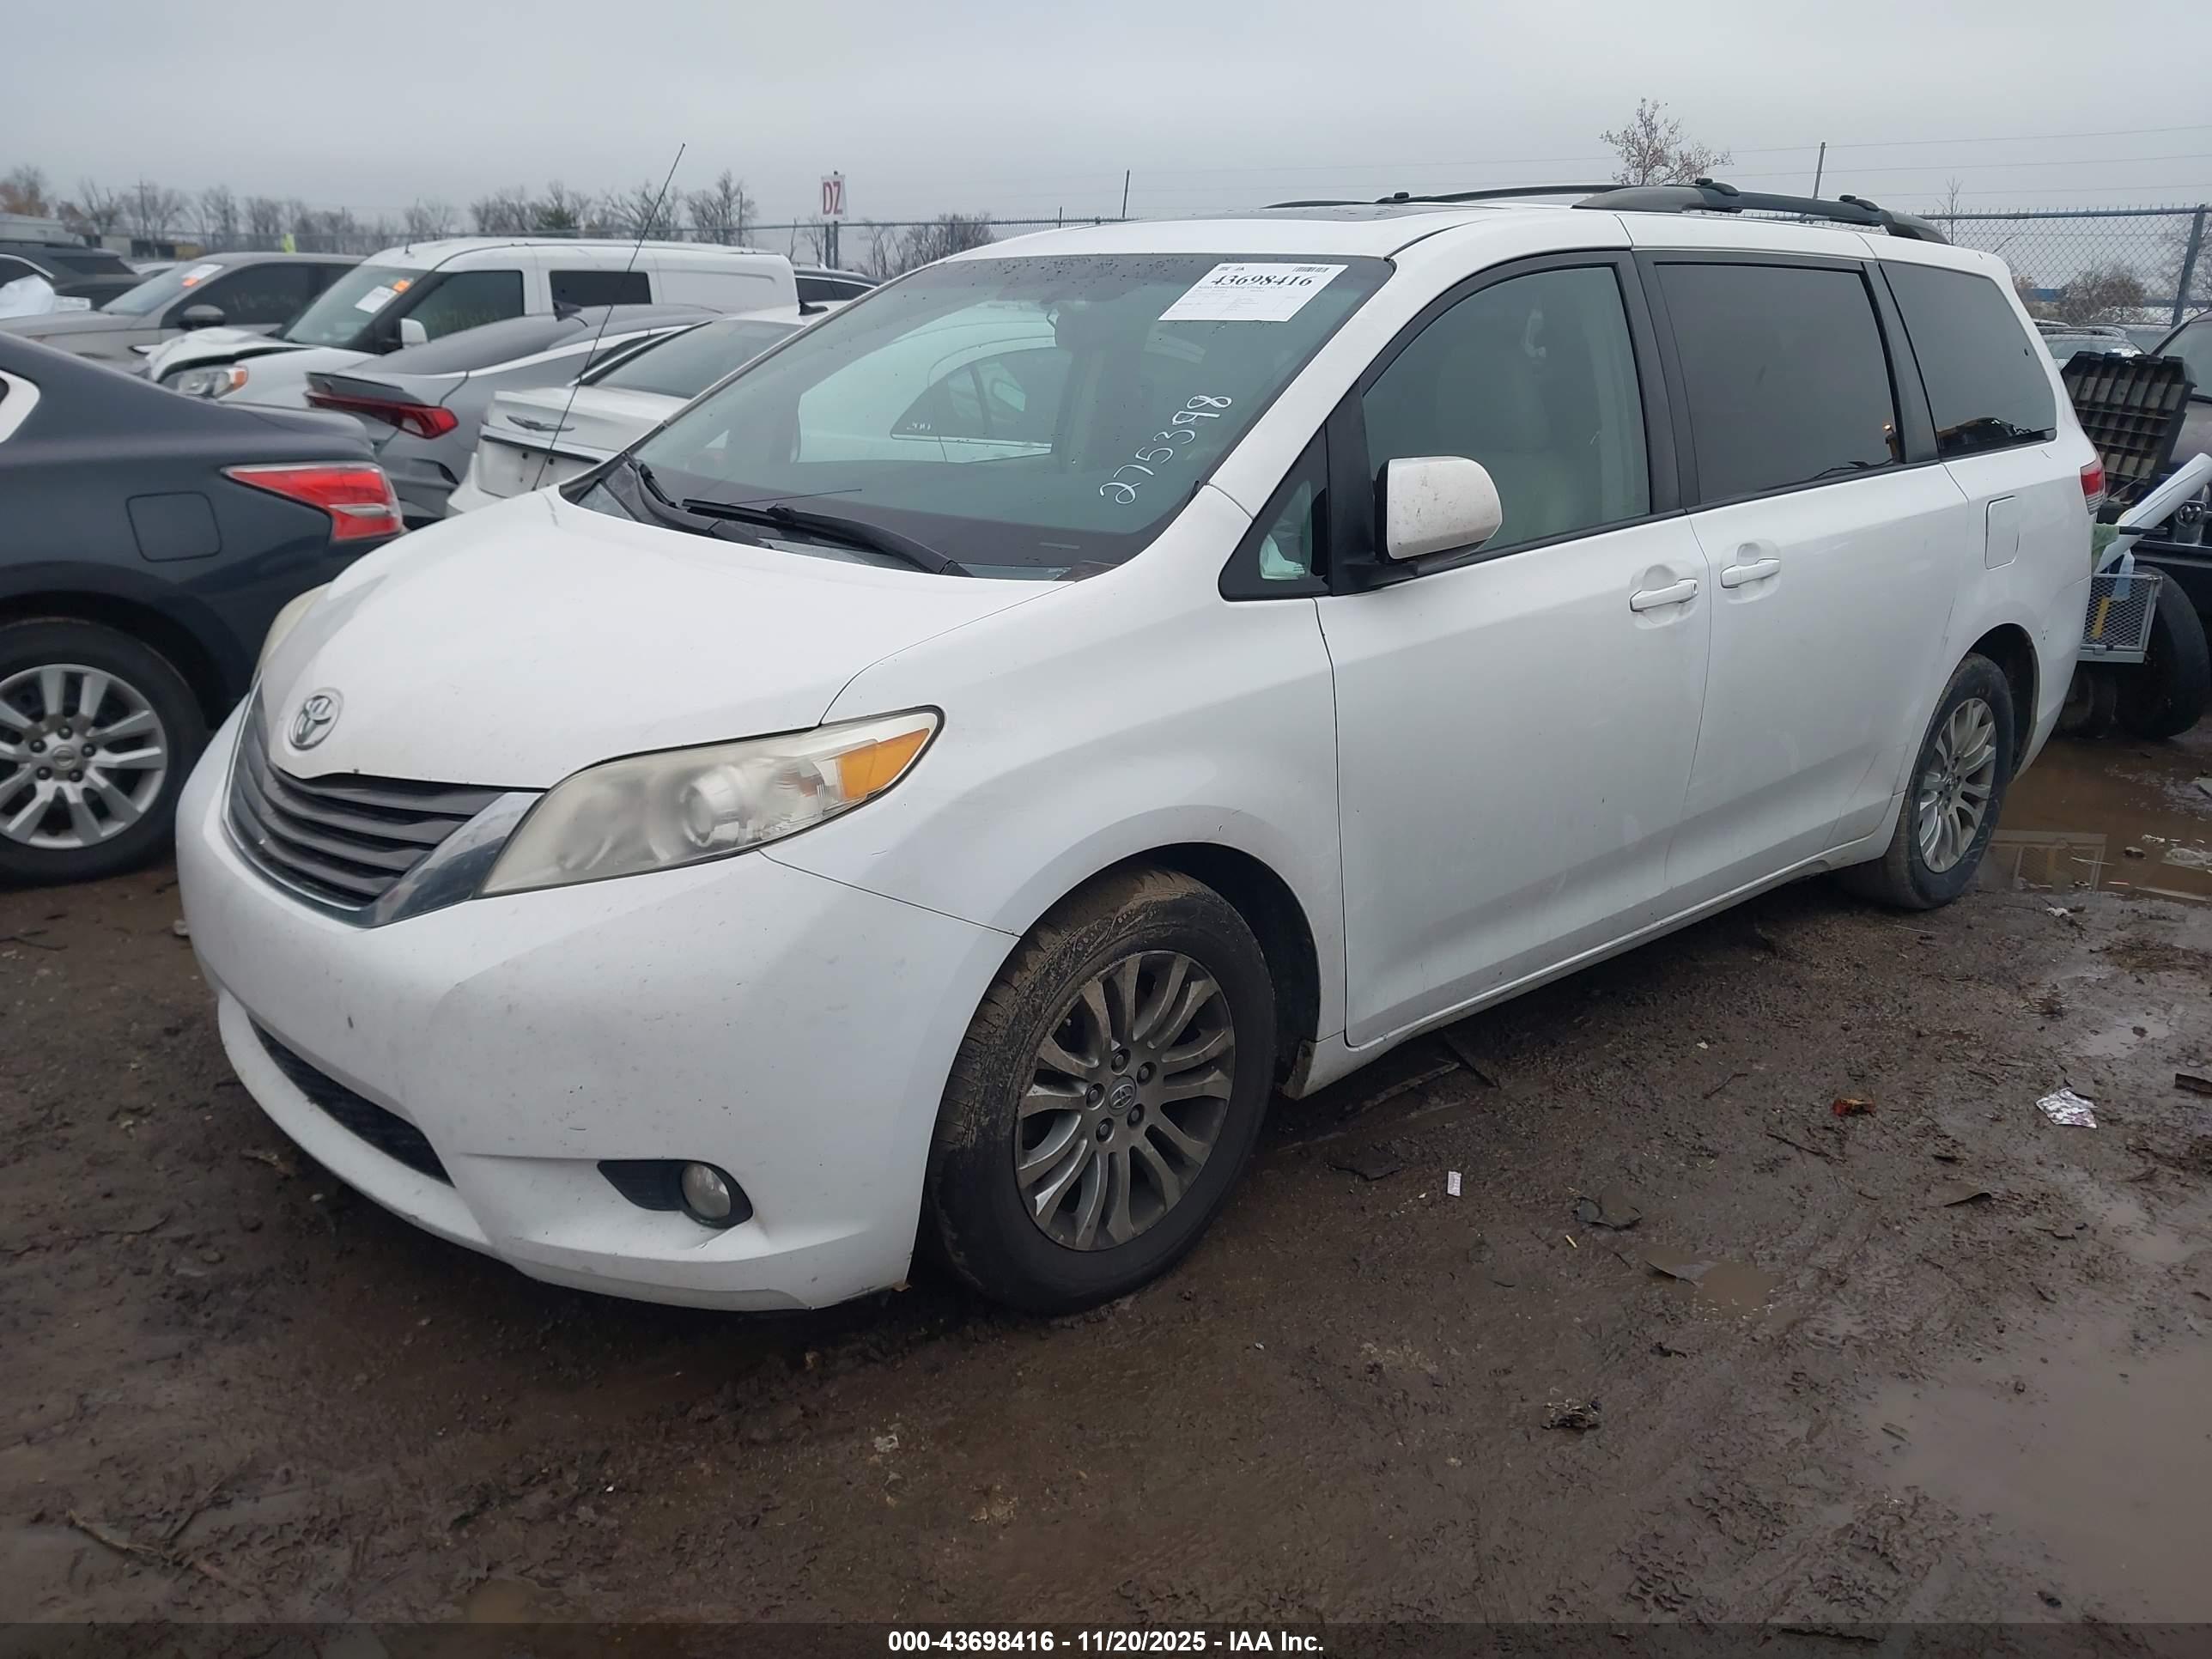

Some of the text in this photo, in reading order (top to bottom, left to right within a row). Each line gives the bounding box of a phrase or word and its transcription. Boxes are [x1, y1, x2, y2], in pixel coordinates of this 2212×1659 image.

[823, 181, 843, 215] DZ
[1210, 274, 1317, 287] 43698416
[1099, 395, 1232, 505] 275398
